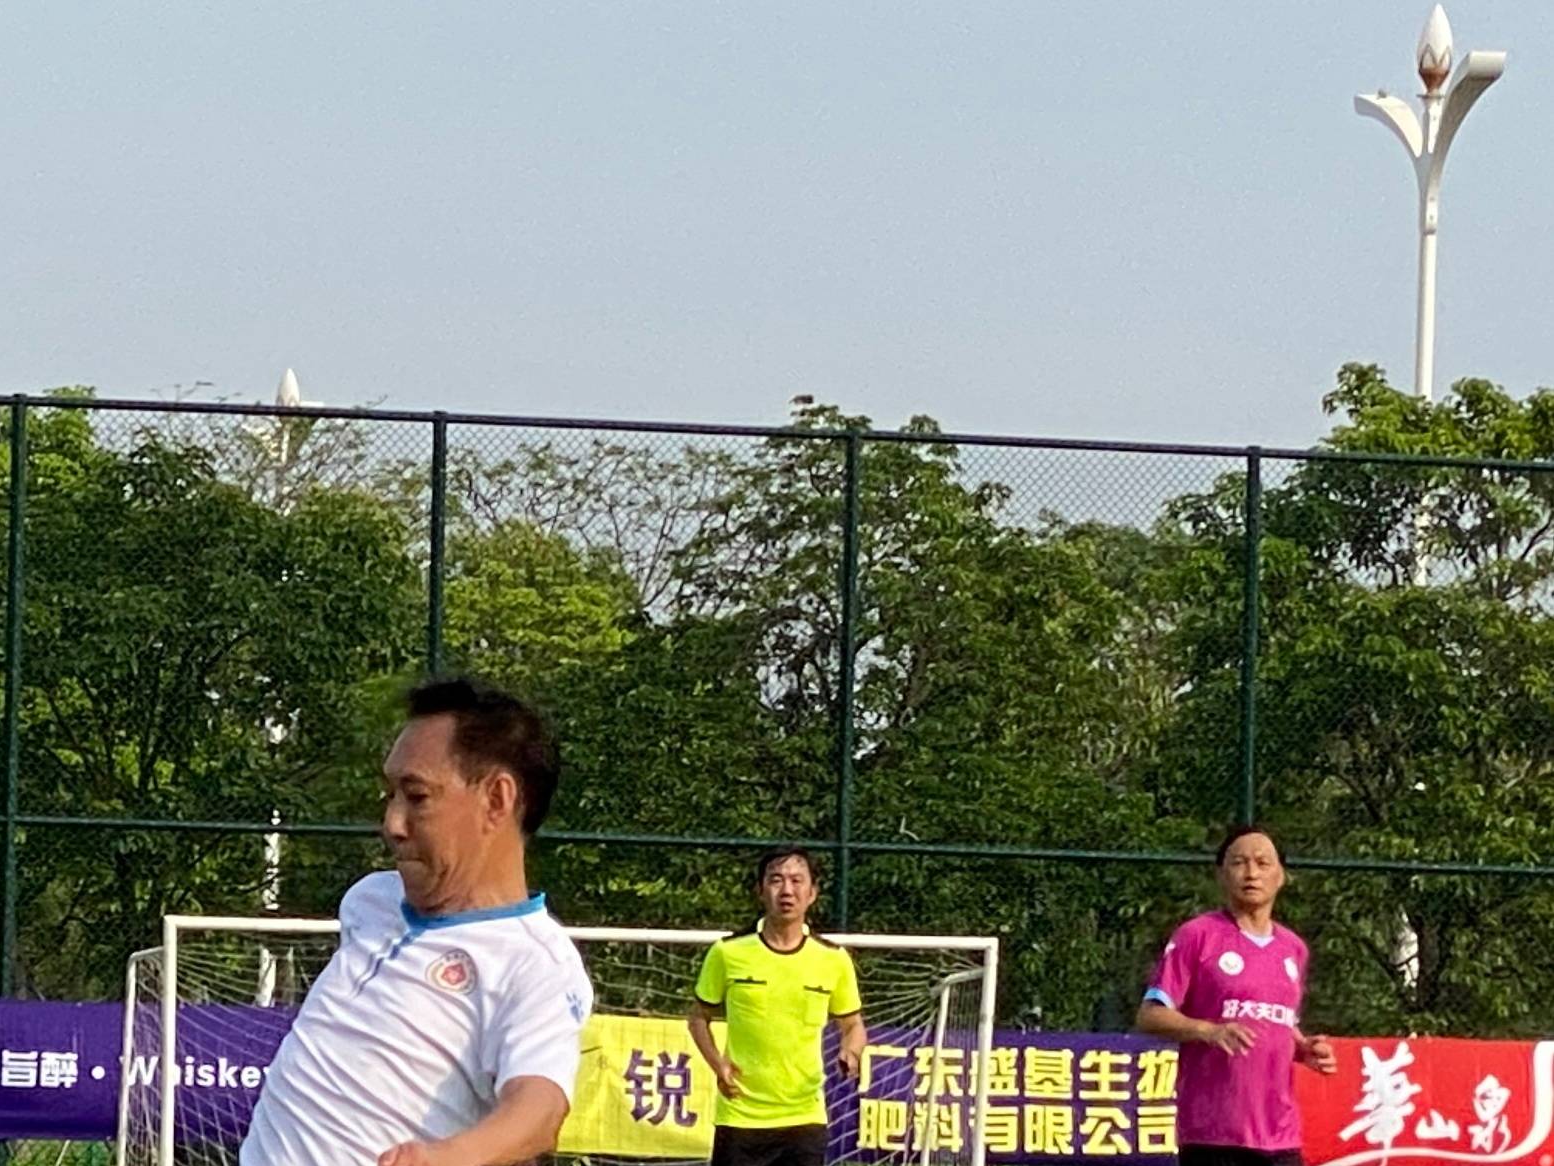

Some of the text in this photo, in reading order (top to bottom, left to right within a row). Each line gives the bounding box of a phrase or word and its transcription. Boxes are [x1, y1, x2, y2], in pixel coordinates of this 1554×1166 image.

[119, 1055, 274, 1089] Wiske
[623, 1048, 698, 1128] 锐
[856, 1098, 1179, 1154] 肥料有限公司
